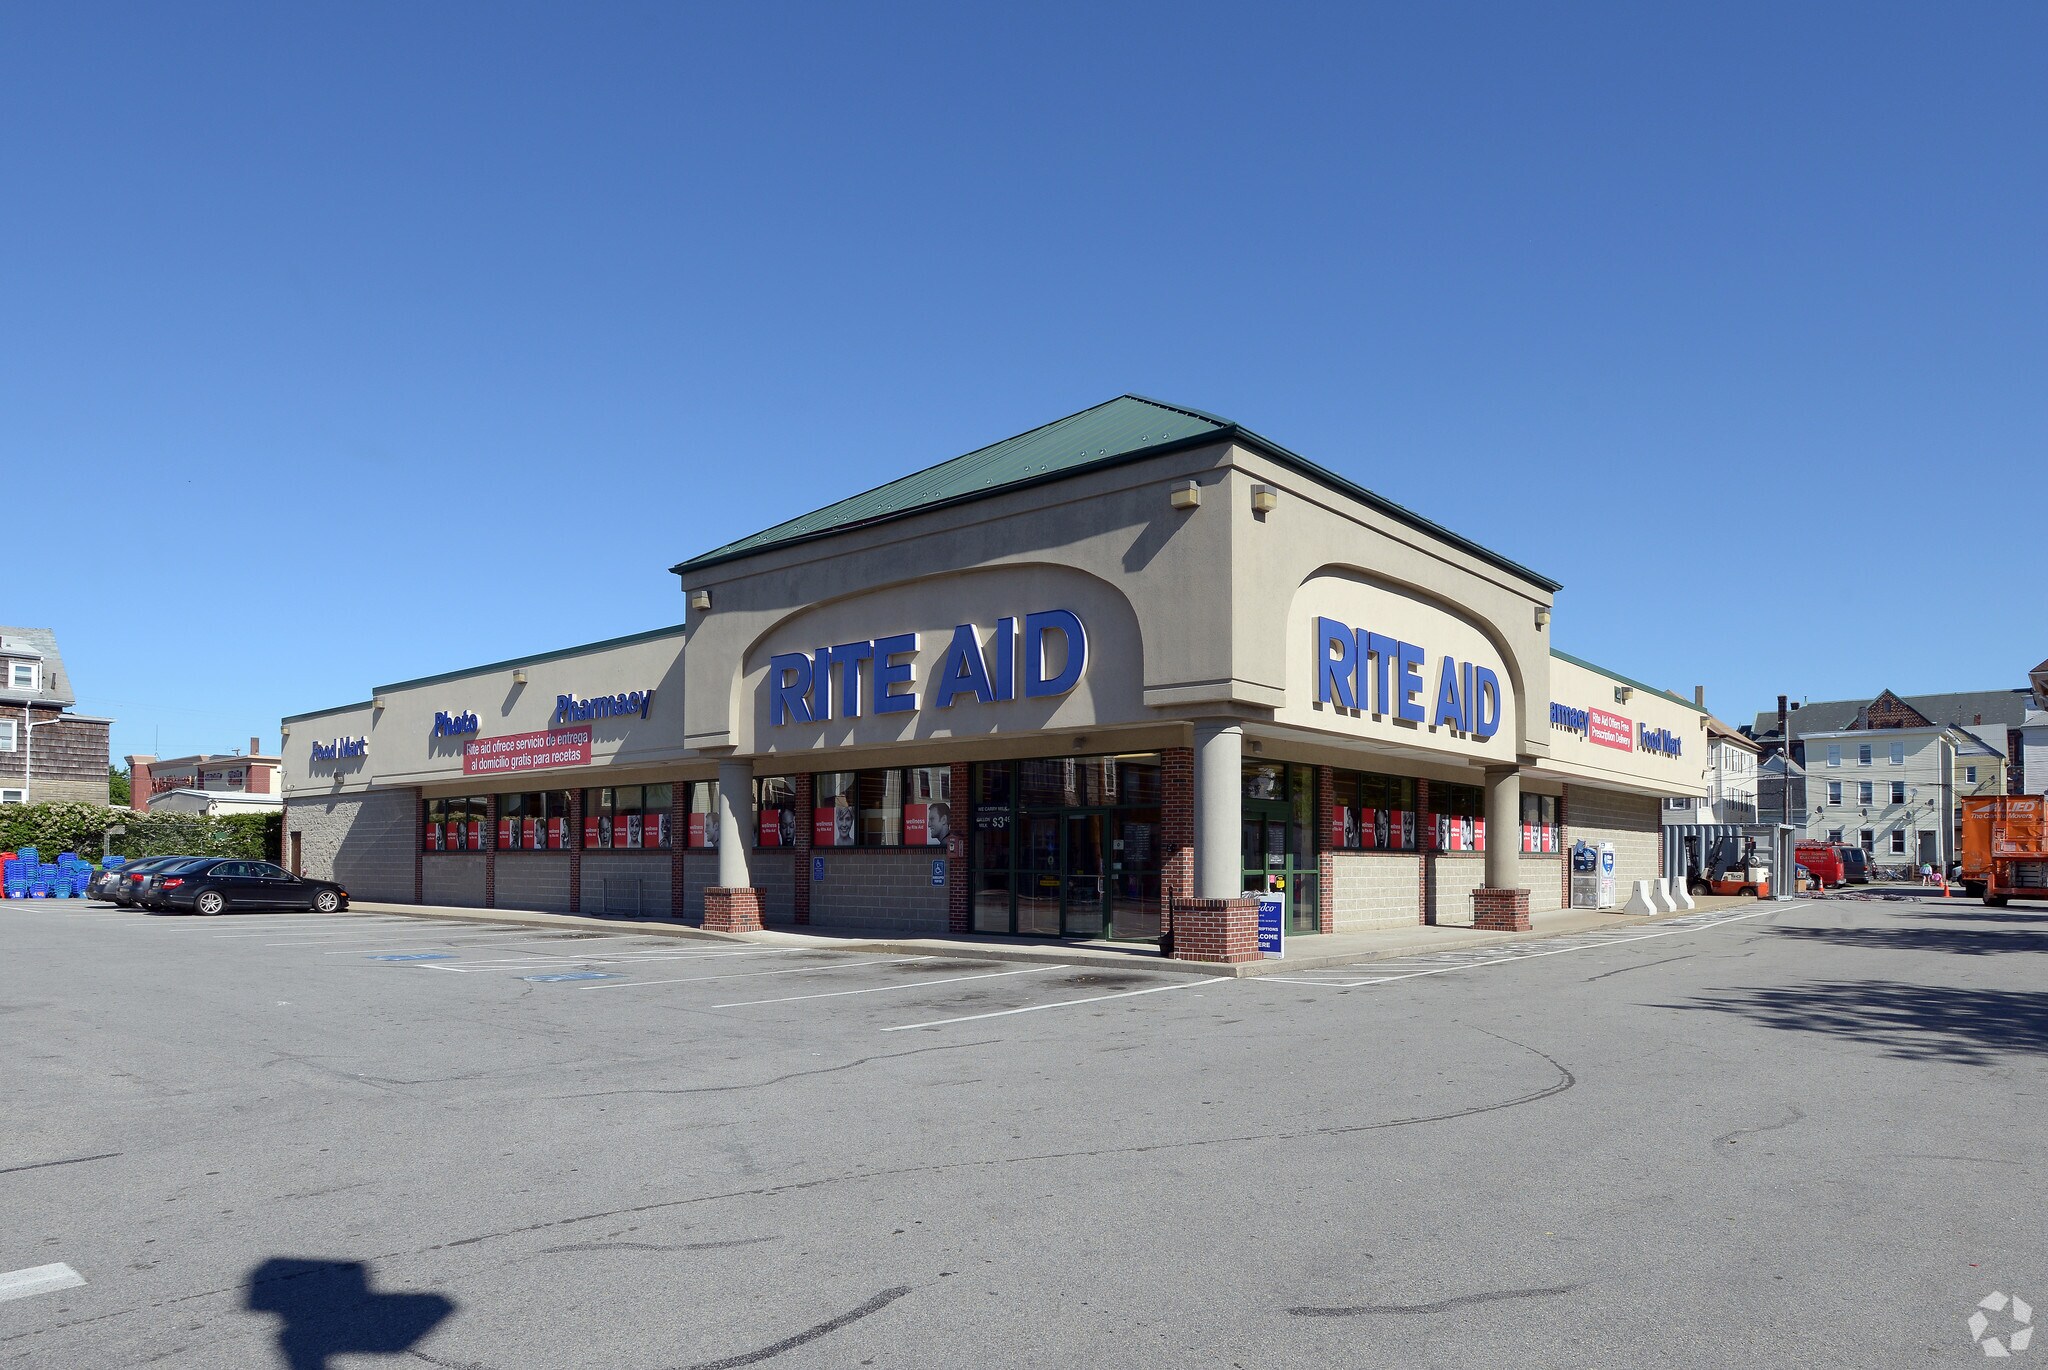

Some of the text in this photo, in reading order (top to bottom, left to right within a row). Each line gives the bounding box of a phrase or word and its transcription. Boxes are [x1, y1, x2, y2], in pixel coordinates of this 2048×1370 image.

[770, 609, 1089, 726] RITE AID
[1314, 616, 1501, 737] RITE AID
[556, 689, 655, 723] Pharmacy
[434, 709, 481, 737] Photo
[312, 736, 368, 761] Food Mart
[466, 731, 588, 756] Rite aid ofrece servicio de entrega
[1637, 722, 1682, 757] Food Mart
[471, 748, 581, 771] al domicilio gratis para recetas
